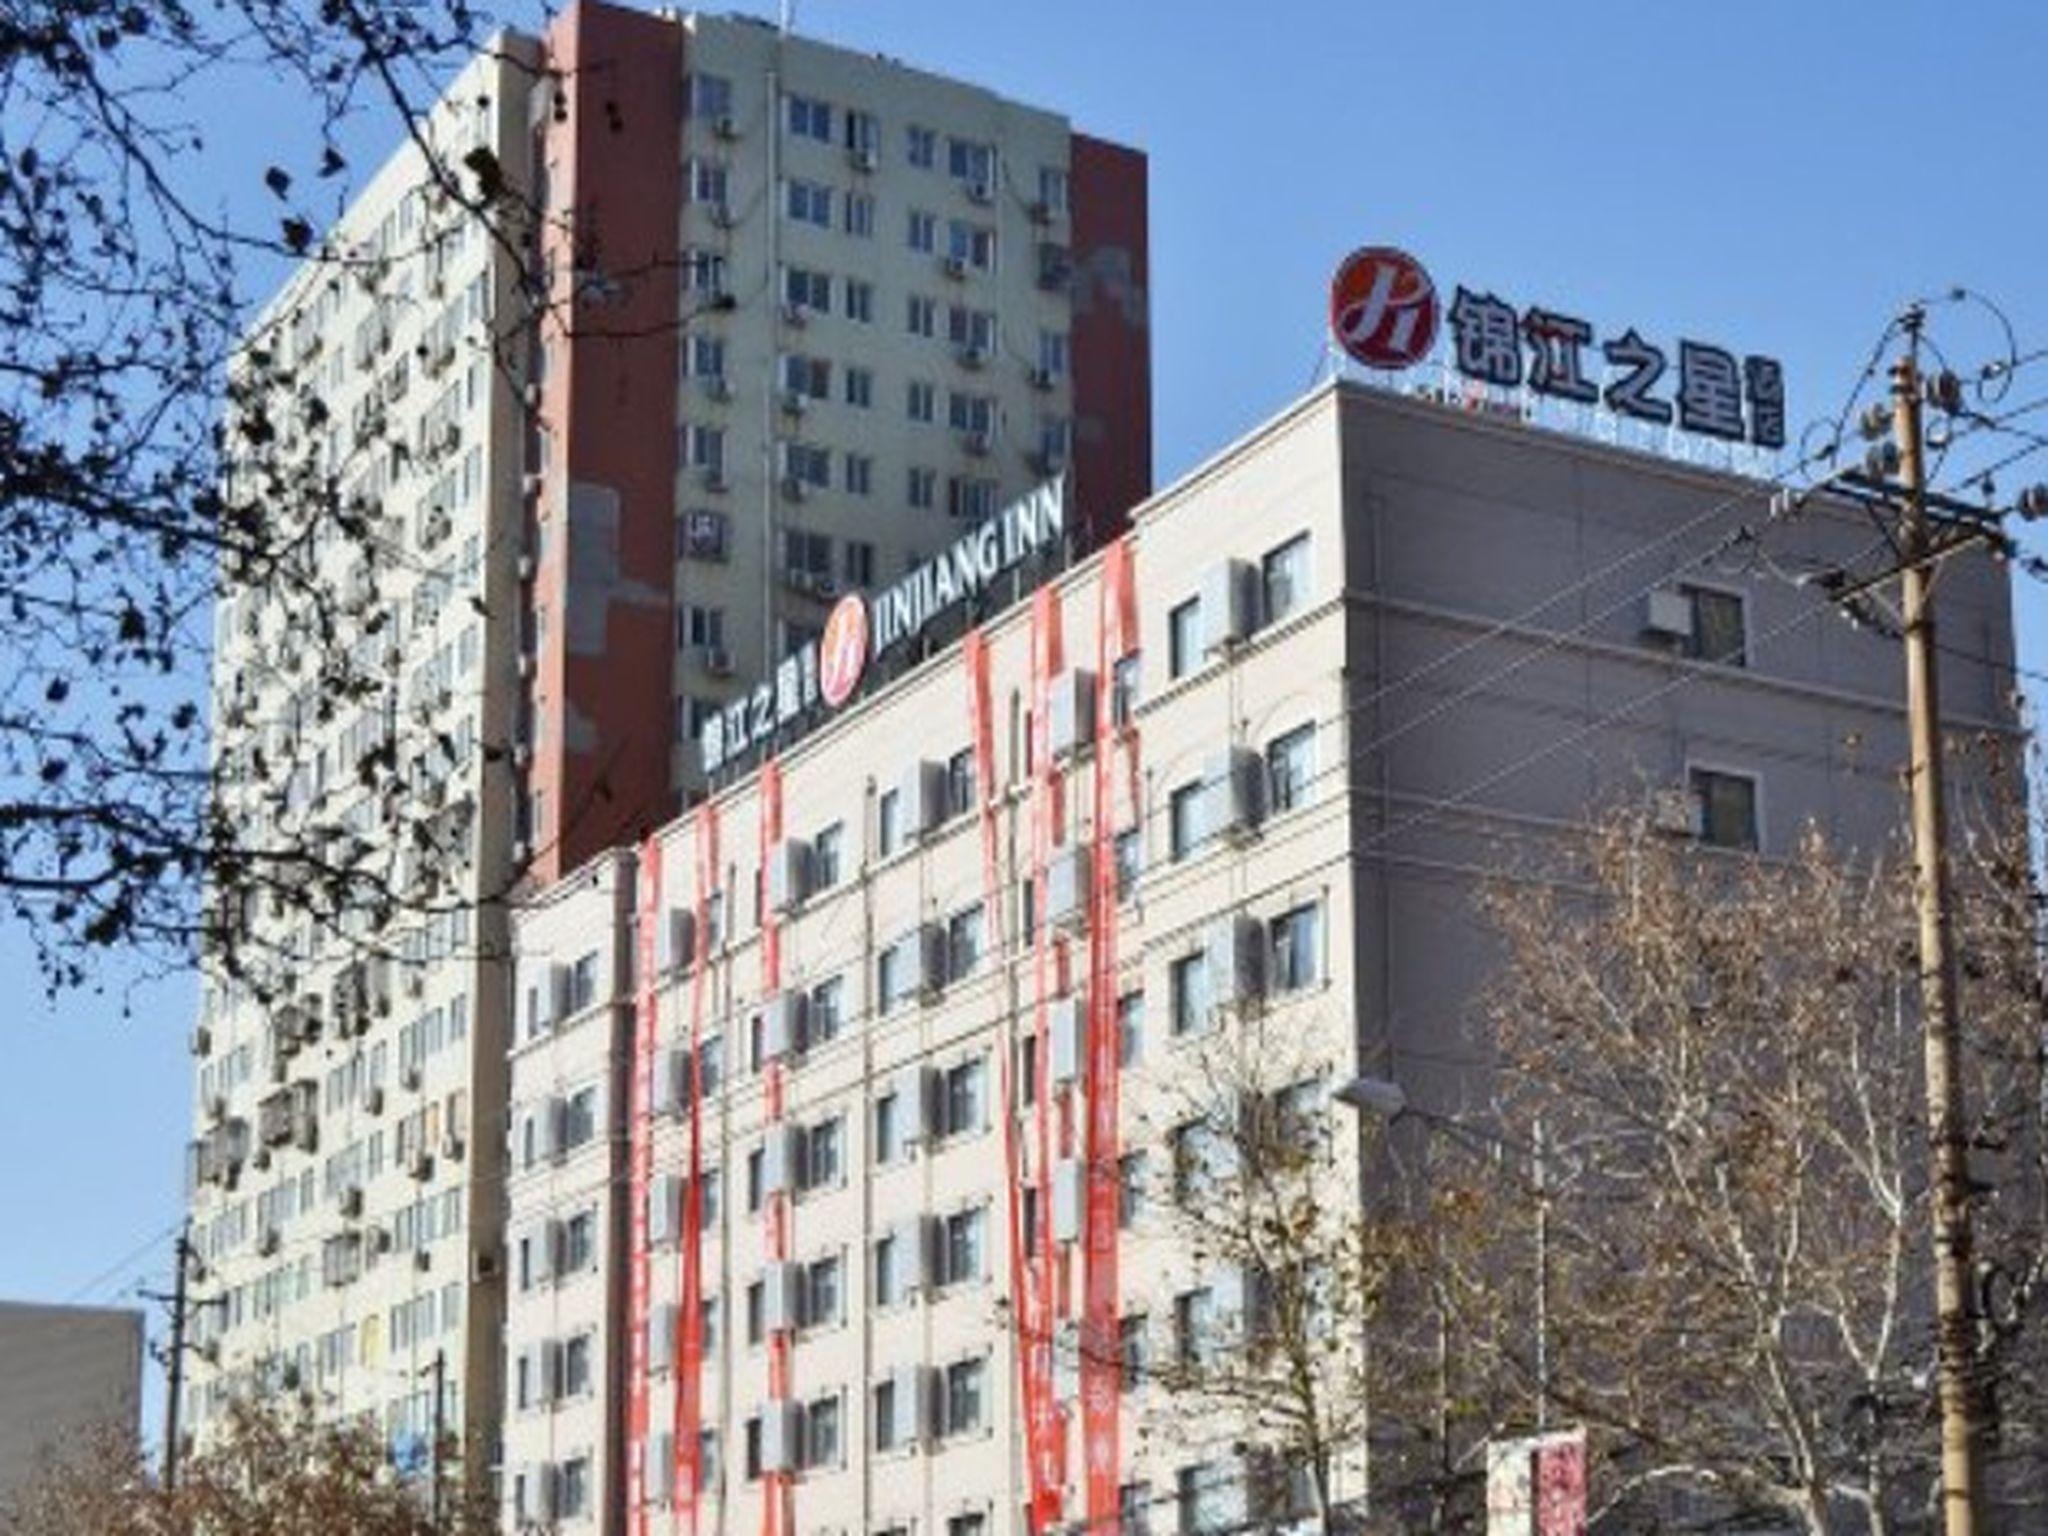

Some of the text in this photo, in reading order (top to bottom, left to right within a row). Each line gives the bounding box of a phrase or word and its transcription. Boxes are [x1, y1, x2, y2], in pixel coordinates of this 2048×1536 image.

[1448, 284, 1746, 442] 锦江之星
[873, 467, 1067, 656] JINJIANG INN
